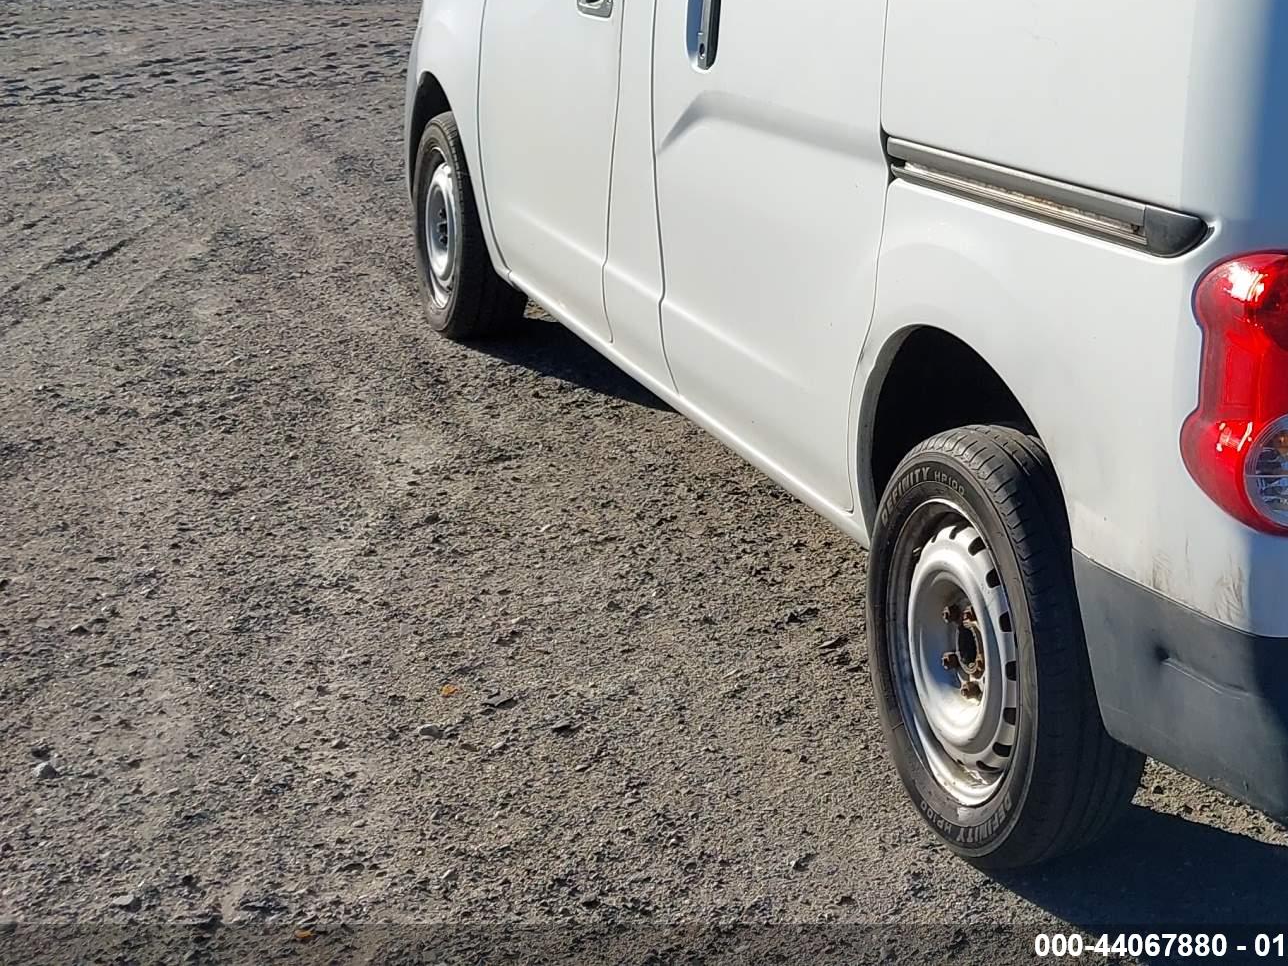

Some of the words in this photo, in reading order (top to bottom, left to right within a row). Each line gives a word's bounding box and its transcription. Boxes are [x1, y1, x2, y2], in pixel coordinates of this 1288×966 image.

[881, 466, 930, 527] DEFINITY
[934, 470, 965, 496] HP100
[920, 800, 952, 833] HP100
[956, 792, 1012, 843] DEFINITY
